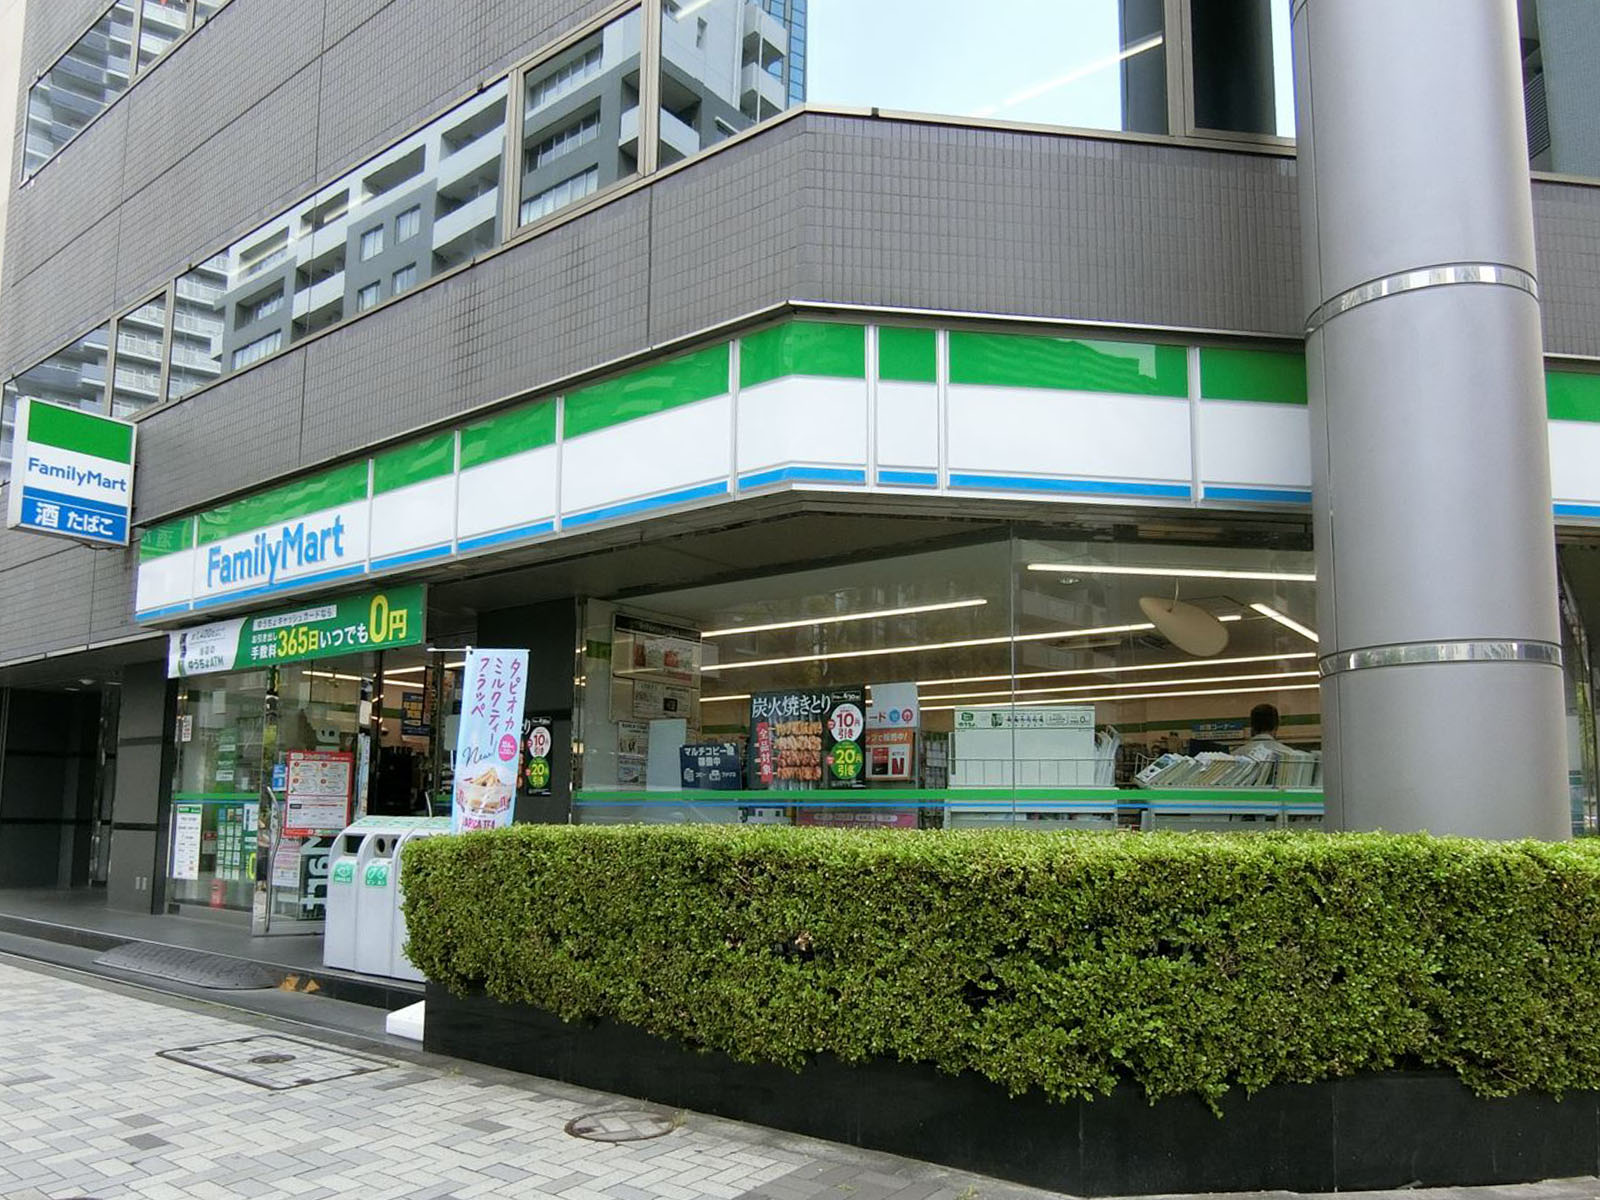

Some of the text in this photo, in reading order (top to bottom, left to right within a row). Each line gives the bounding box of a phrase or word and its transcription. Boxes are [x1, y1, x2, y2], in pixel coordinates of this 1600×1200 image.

[28, 457, 127, 493] FamilyMart
[35, 502, 114, 536] 酒 たばこ
[207, 515, 345, 588] FamilyMart
[471, 657, 490, 718] フラッペ
[488, 658, 505, 746] ミルクティー
[504, 658, 521, 731] タピオカ
[752, 693, 832, 718] 炭火焼きとり
